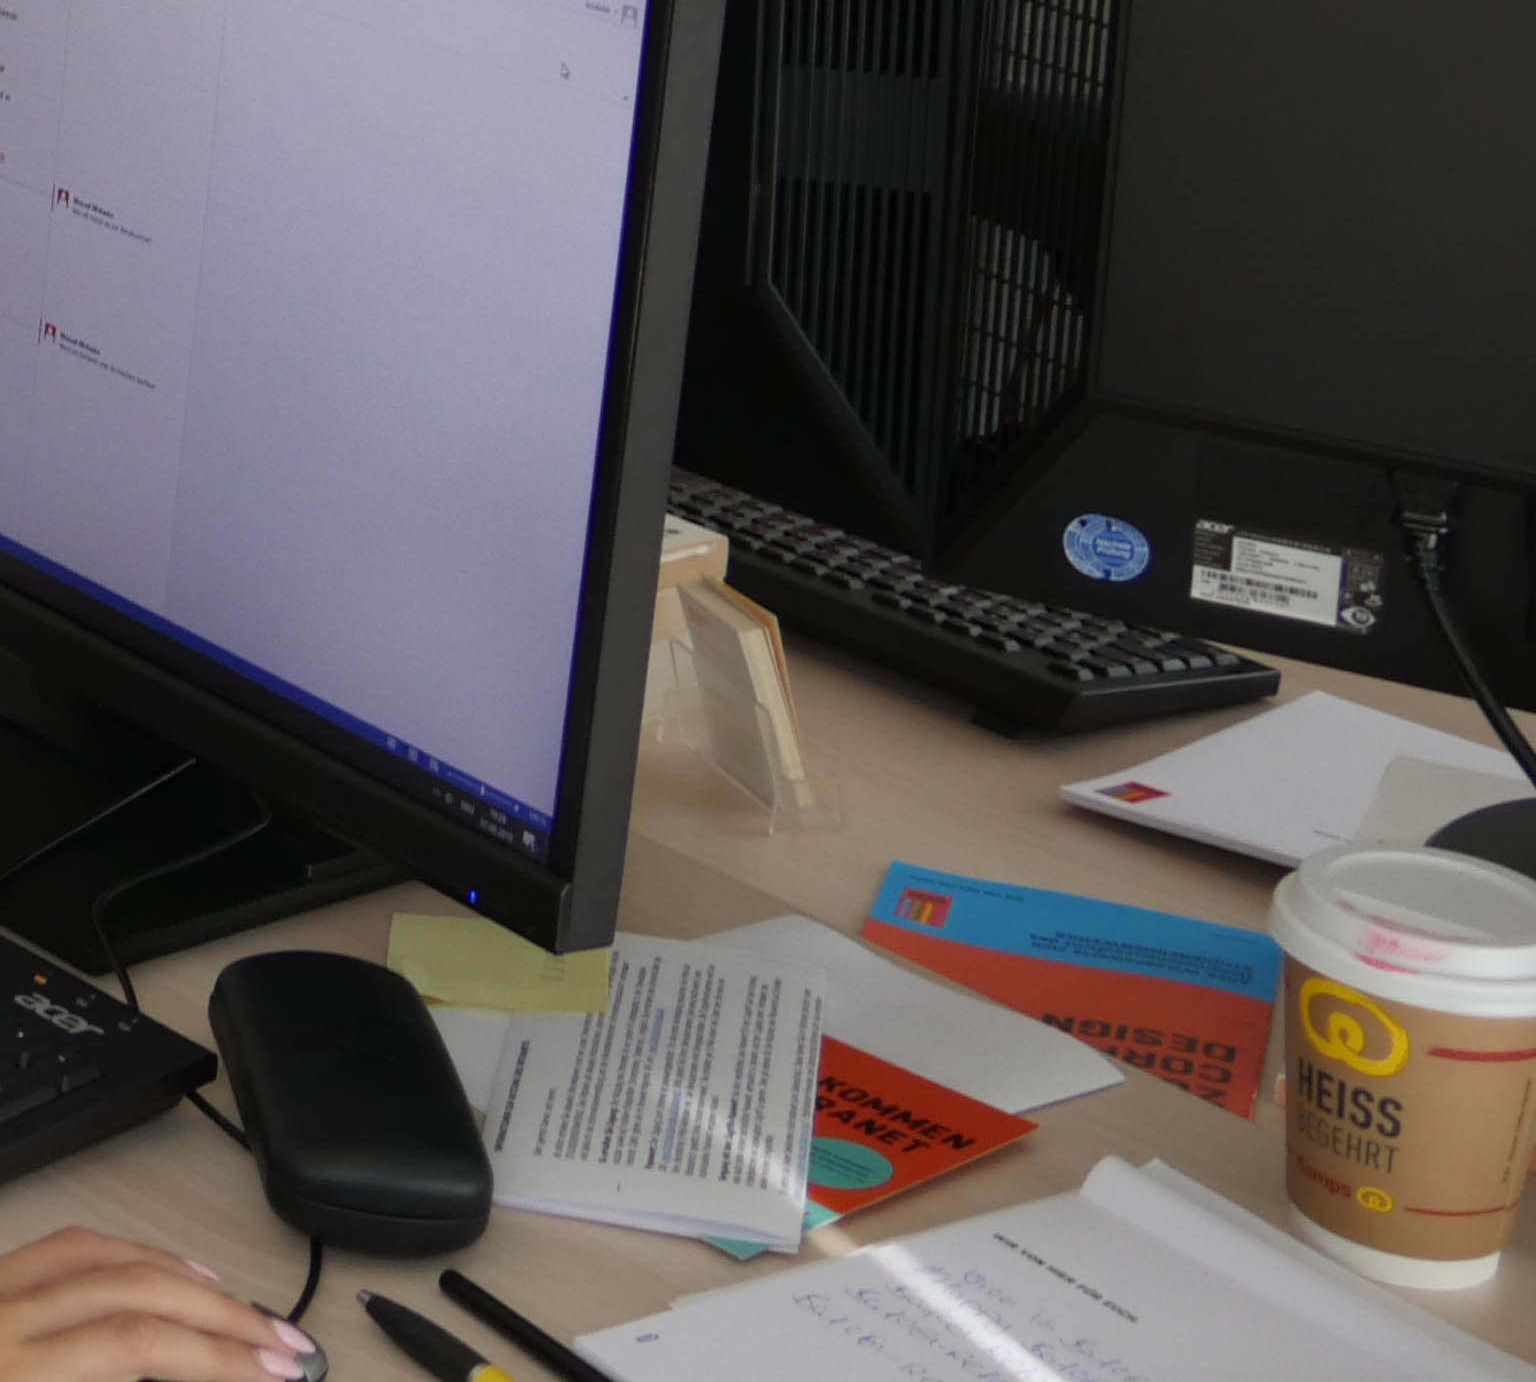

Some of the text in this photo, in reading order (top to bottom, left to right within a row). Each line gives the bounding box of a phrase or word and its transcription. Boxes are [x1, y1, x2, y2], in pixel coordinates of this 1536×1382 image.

[14, 992, 104, 1035] acer
[1041, 1014, 1237, 1063] DESIGN
[817, 1076, 976, 1151] KOMMEN
[1298, 1057, 1403, 1139] HEISS
